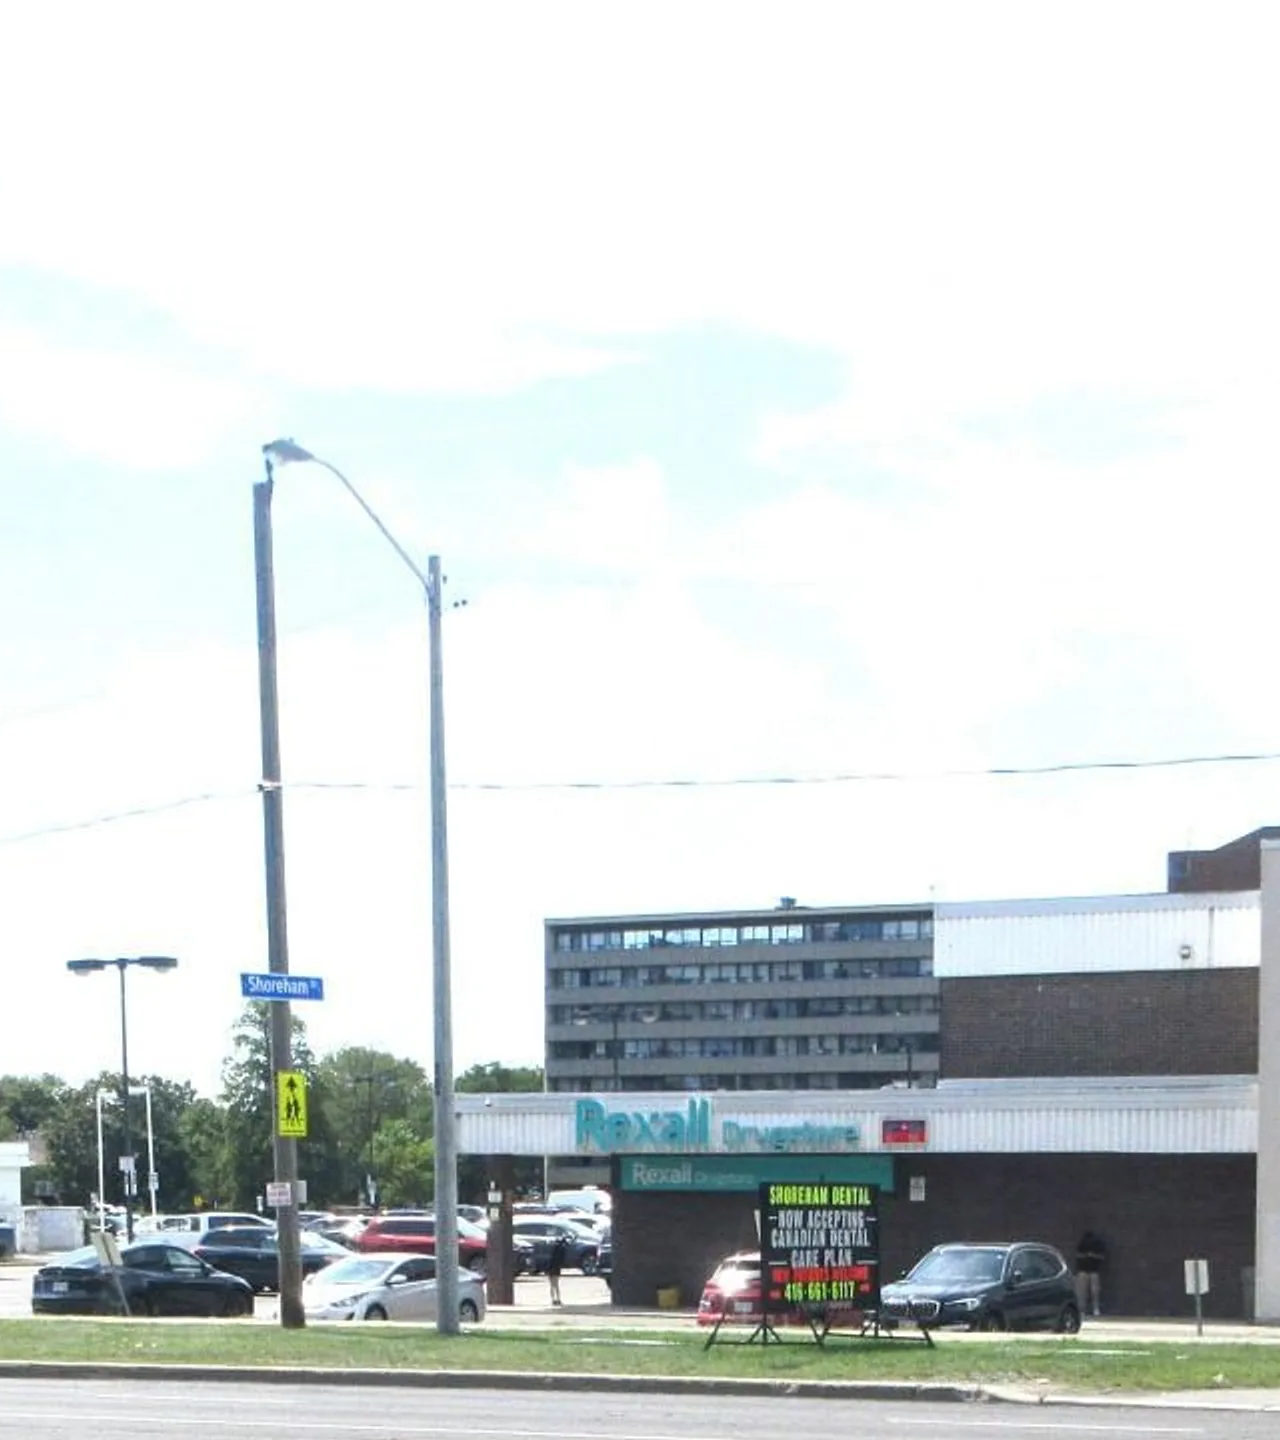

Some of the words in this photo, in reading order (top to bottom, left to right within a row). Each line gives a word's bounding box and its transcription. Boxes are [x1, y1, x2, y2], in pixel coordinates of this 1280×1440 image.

[247, 976, 308, 994] Shoreham
[576, 1097, 710, 1150] Rexall
[722, 1119, 860, 1151] Drugstore
[632, 1161, 692, 1184] Rexall
[769, 1185, 828, 1205] SHOREHAM
[832, 1186, 871, 1205] DENTAL
[778, 1209, 803, 1228] NOW
[807, 1210, 865, 1229] ACCEPTING
[771, 1228, 826, 1248] CANADIAN
[830, 1229, 871, 1247] DENTAL
[791, 1248, 819, 1268] CARE
[824, 1249, 852, 1268] PLAN
